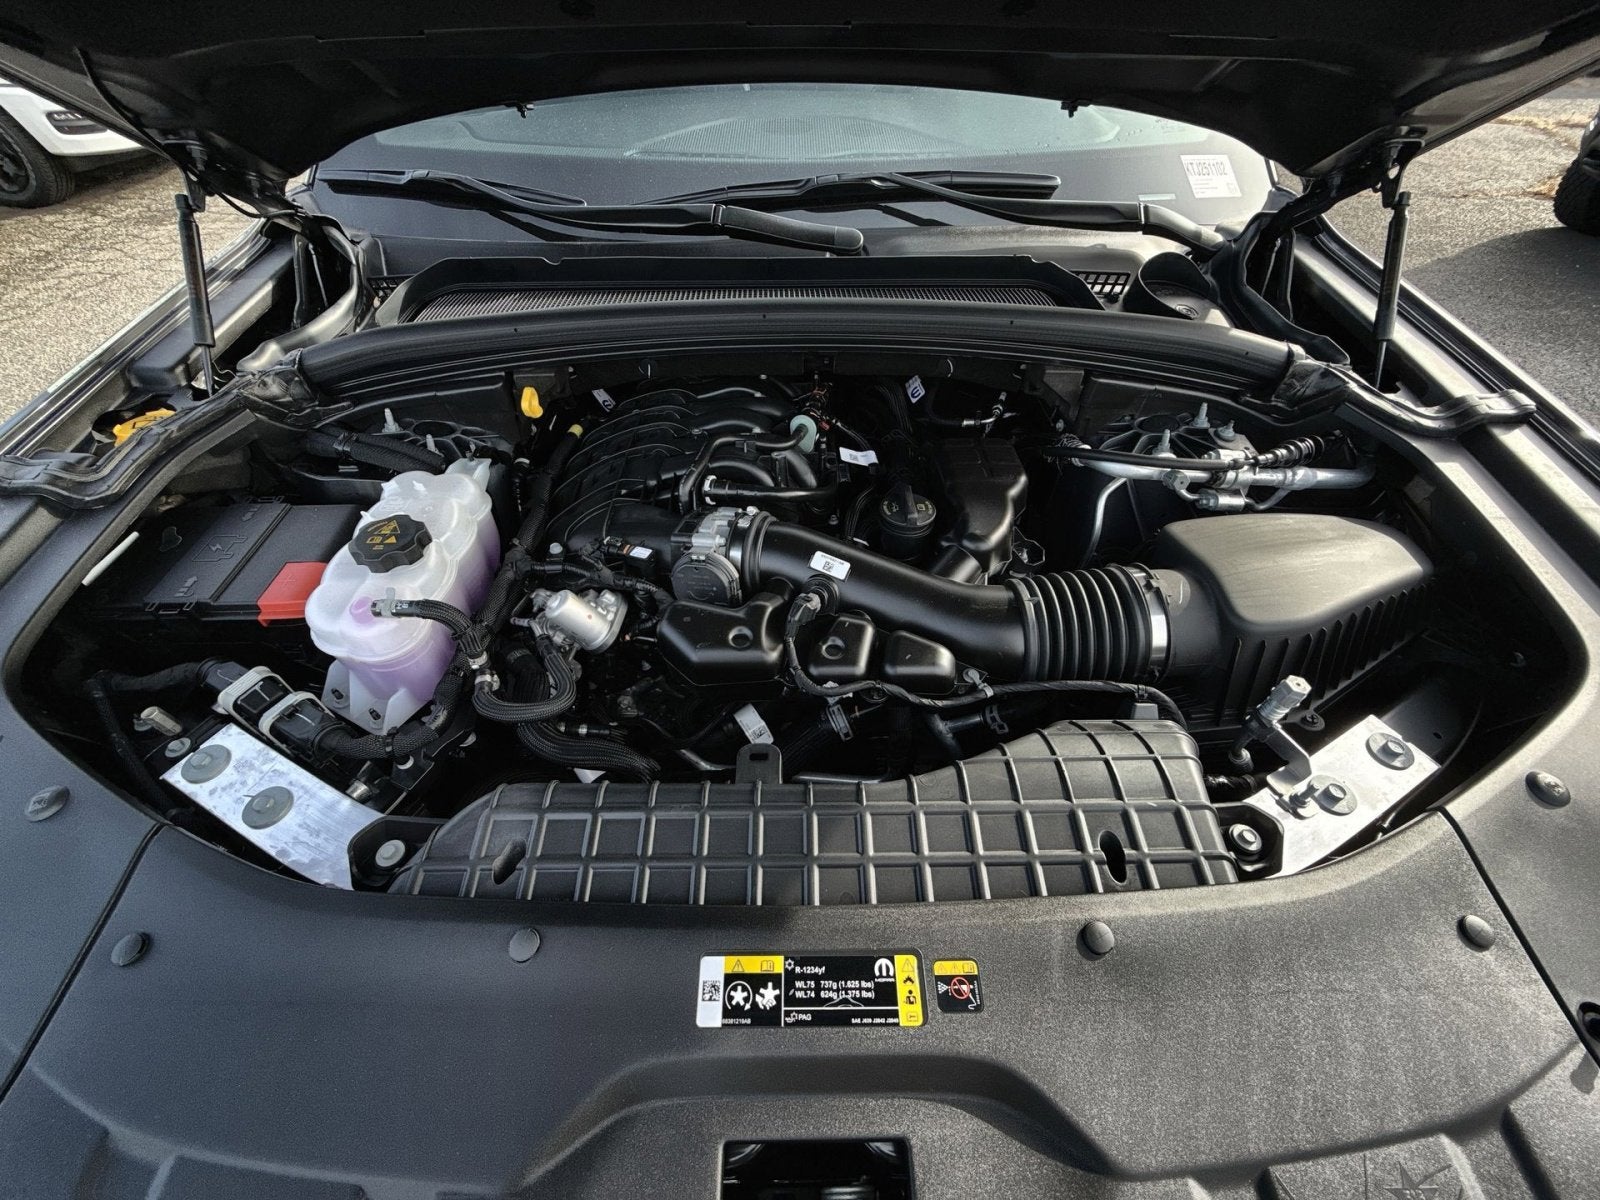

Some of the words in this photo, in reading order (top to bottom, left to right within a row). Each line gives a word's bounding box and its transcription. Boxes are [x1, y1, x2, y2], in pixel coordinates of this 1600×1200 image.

[795, 966, 826, 975] R-1234yf
[795, 980, 815, 988] WL75
[820, 980, 837, 989] 737g
[838, 980, 860, 989] (1.625
[861, 980, 875, 989] lbs)
[795, 990, 815, 998] WL74
[820, 990, 837, 999] 624g
[838, 990, 860, 999] (1.375
[861, 990, 875, 999] lbs)
[798, 1013, 812, 1021] PAG
